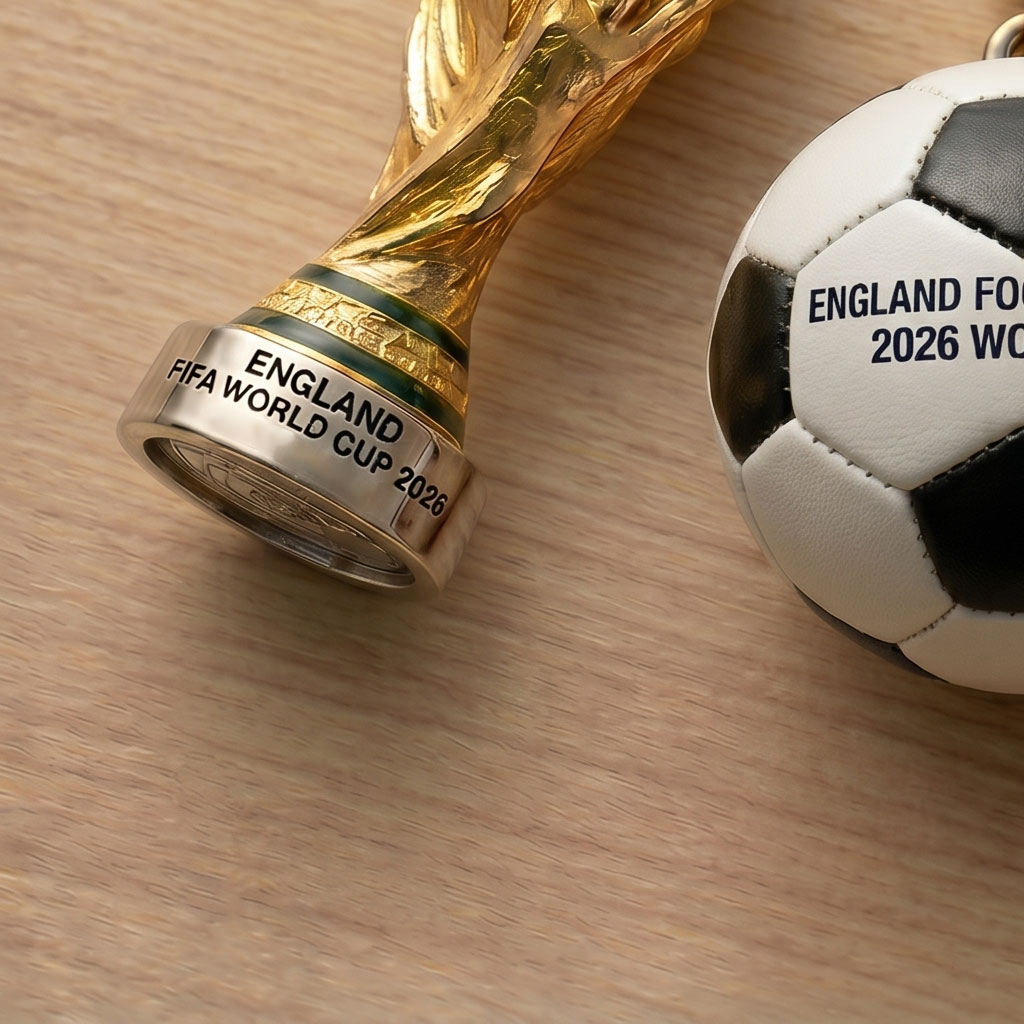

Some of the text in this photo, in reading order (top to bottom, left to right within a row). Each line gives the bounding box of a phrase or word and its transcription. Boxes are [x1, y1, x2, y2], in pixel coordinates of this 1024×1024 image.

[809, 277, 961, 323] ENGLAND
[871, 325, 959, 363] 2026
[245, 349, 404, 444] ENGLAND
[167, 359, 448, 517] FIFA WORLD CUP 2026
